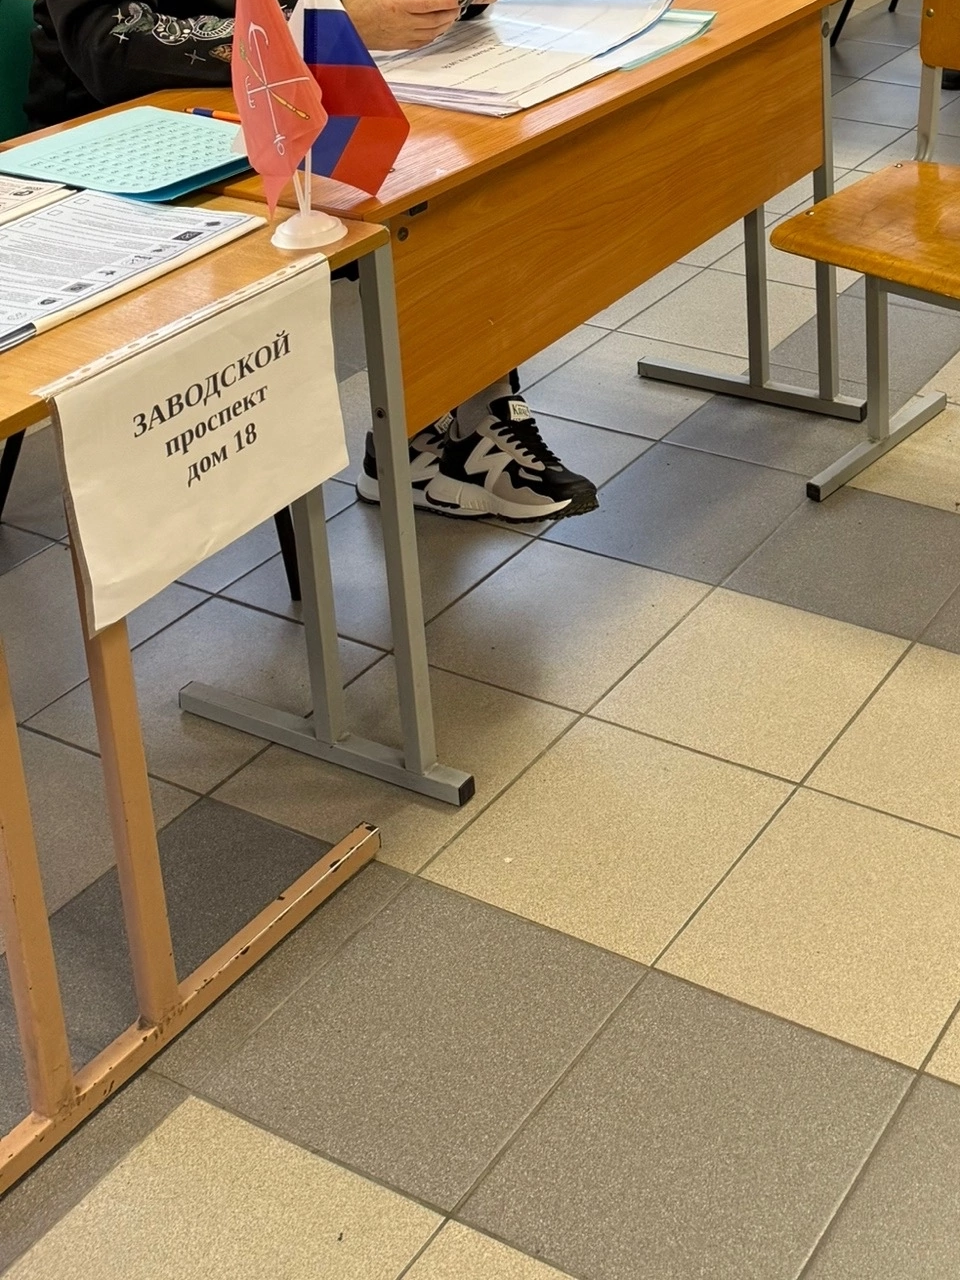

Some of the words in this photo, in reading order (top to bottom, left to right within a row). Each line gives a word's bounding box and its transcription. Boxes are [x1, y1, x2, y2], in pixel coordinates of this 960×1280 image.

[132, 330, 291, 438] ЗАВОДСКОЙ
[165, 385, 268, 458] проспект
[187, 445, 229, 488] дом
[233, 422, 258, 453] 18
